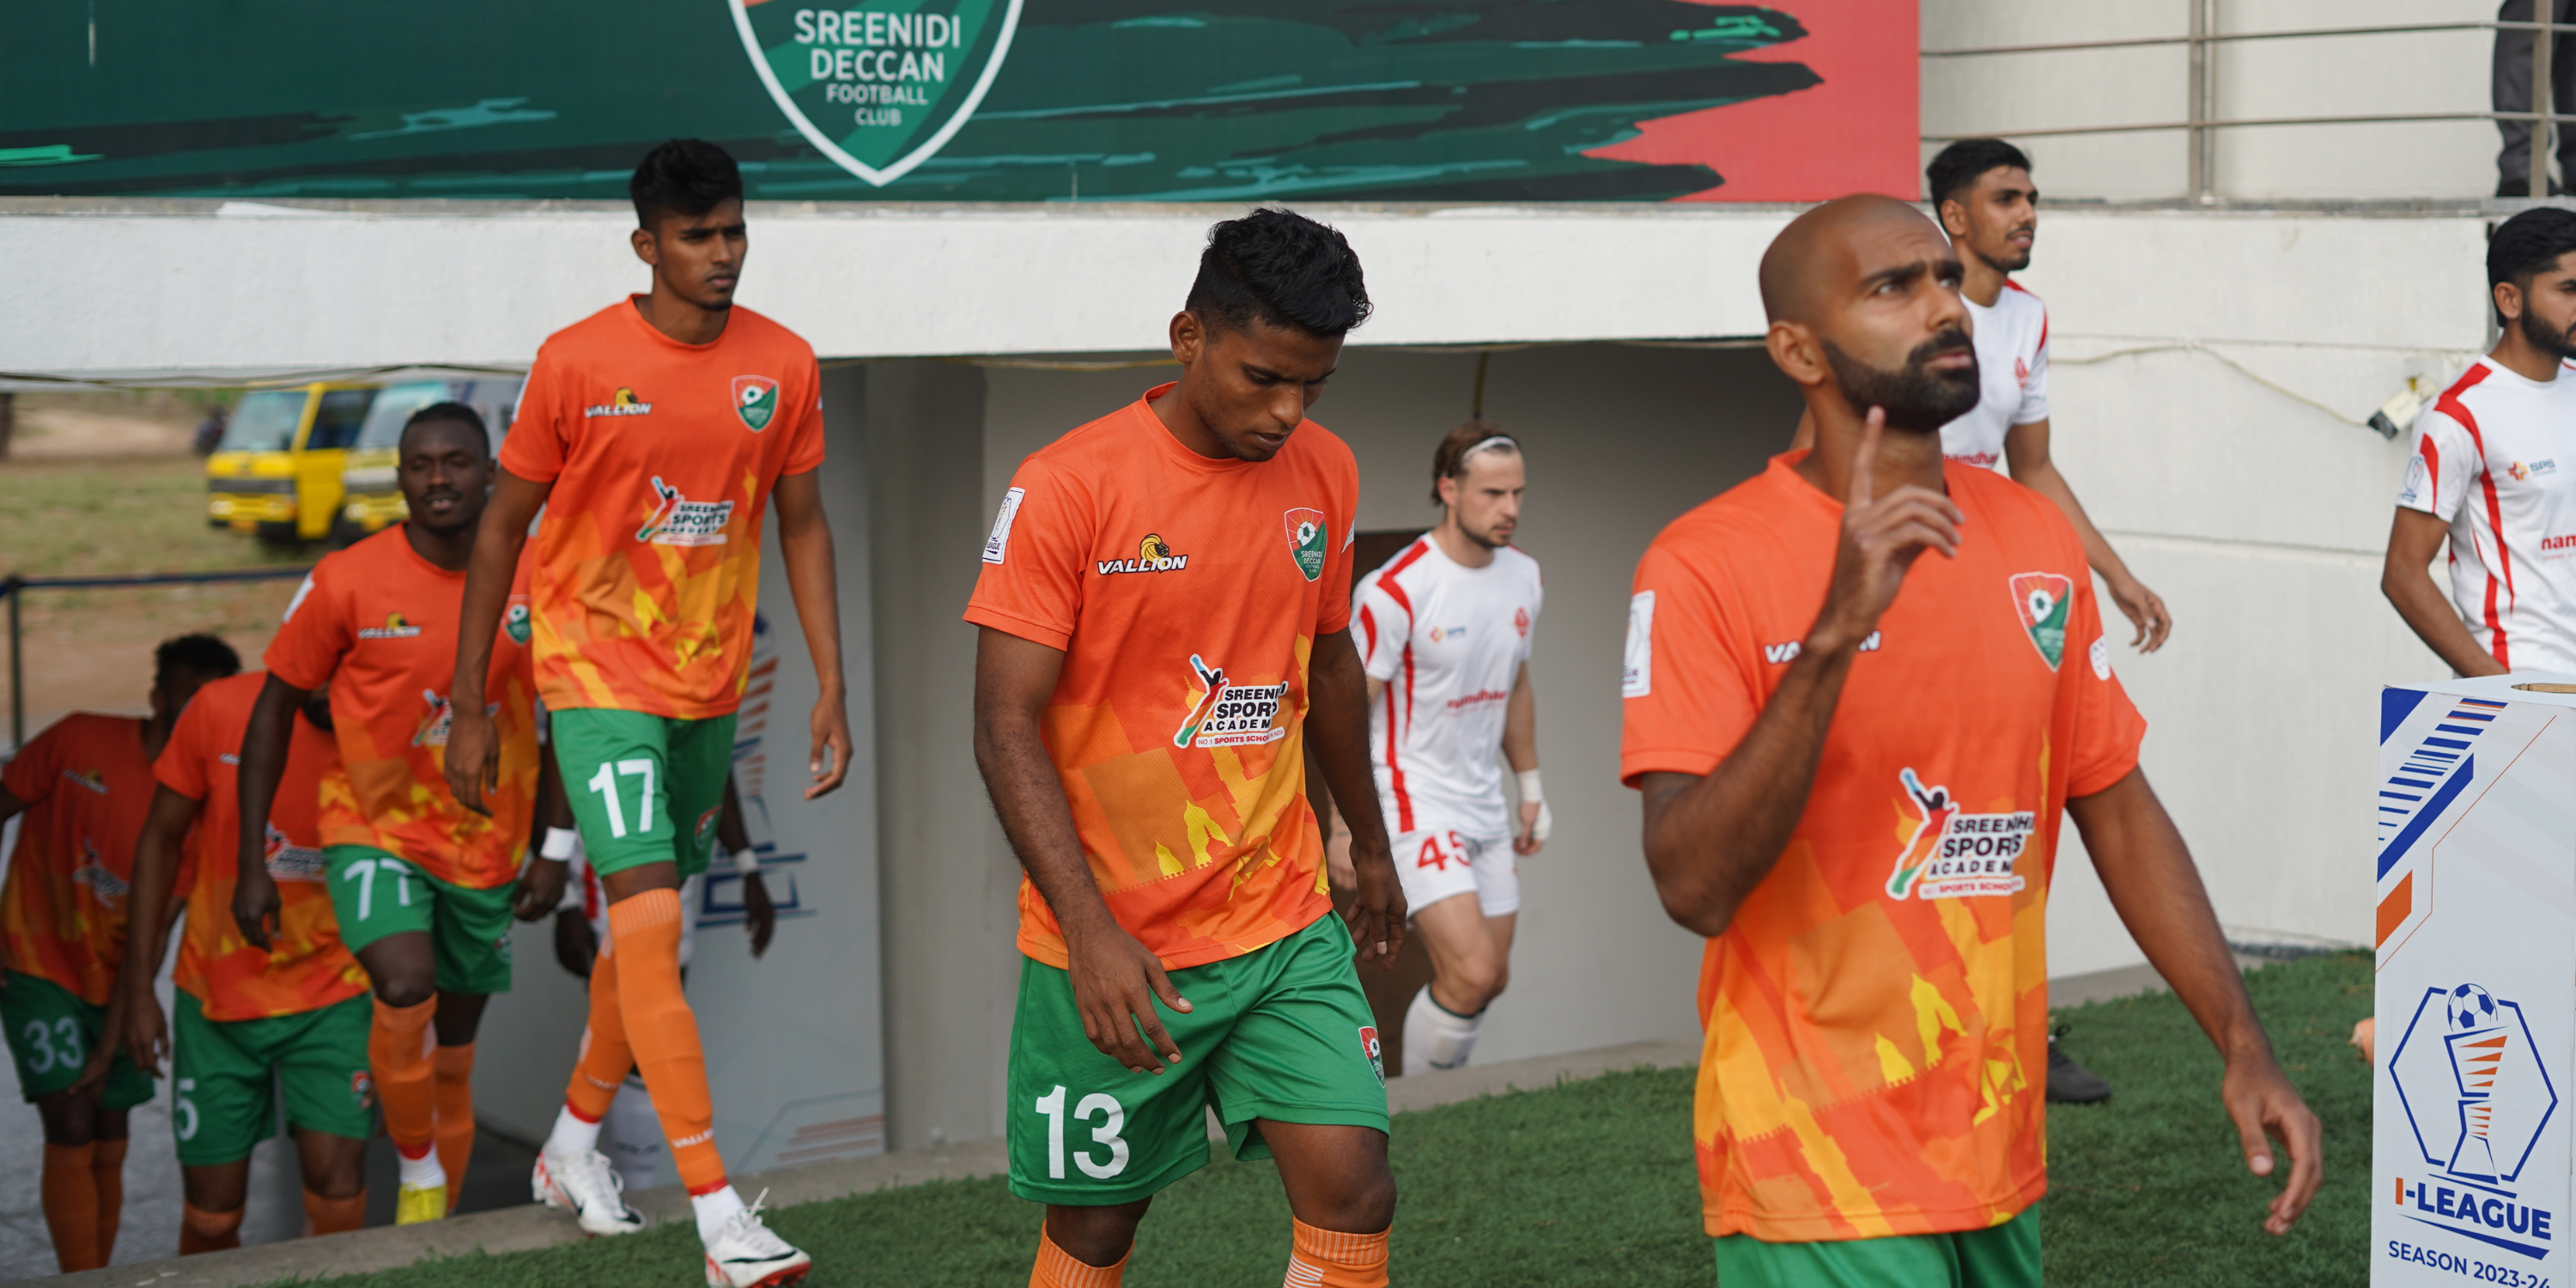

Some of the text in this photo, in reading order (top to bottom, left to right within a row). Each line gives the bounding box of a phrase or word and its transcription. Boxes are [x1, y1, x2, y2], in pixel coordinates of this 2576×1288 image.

[794, 9, 961, 48] SREENIDI
[811, 49, 945, 82] DECCAN
[826, 84, 928, 106] FOOTBALL
[854, 107, 902, 126] CLUB
[585, 402, 653, 419] VALLION
[1098, 556, 1188, 574] VALLION
[1204, 719, 1272, 732] ACADEM
[1214, 736, 1244, 744] SPORTS
[589, 758, 654, 838] 17
[1417, 830, 1472, 872] 45
[1929, 860, 2013, 876] ACADEM
[343, 858, 413, 922] 77
[23, 1017, 84, 1073] 33
[176, 1078, 198, 1141] 5
[1036, 1084, 1130, 1180] 13
[2395, 1176, 2552, 1242] I-LEAGUE
[2388, 1240, 2468, 1276] SEASON
